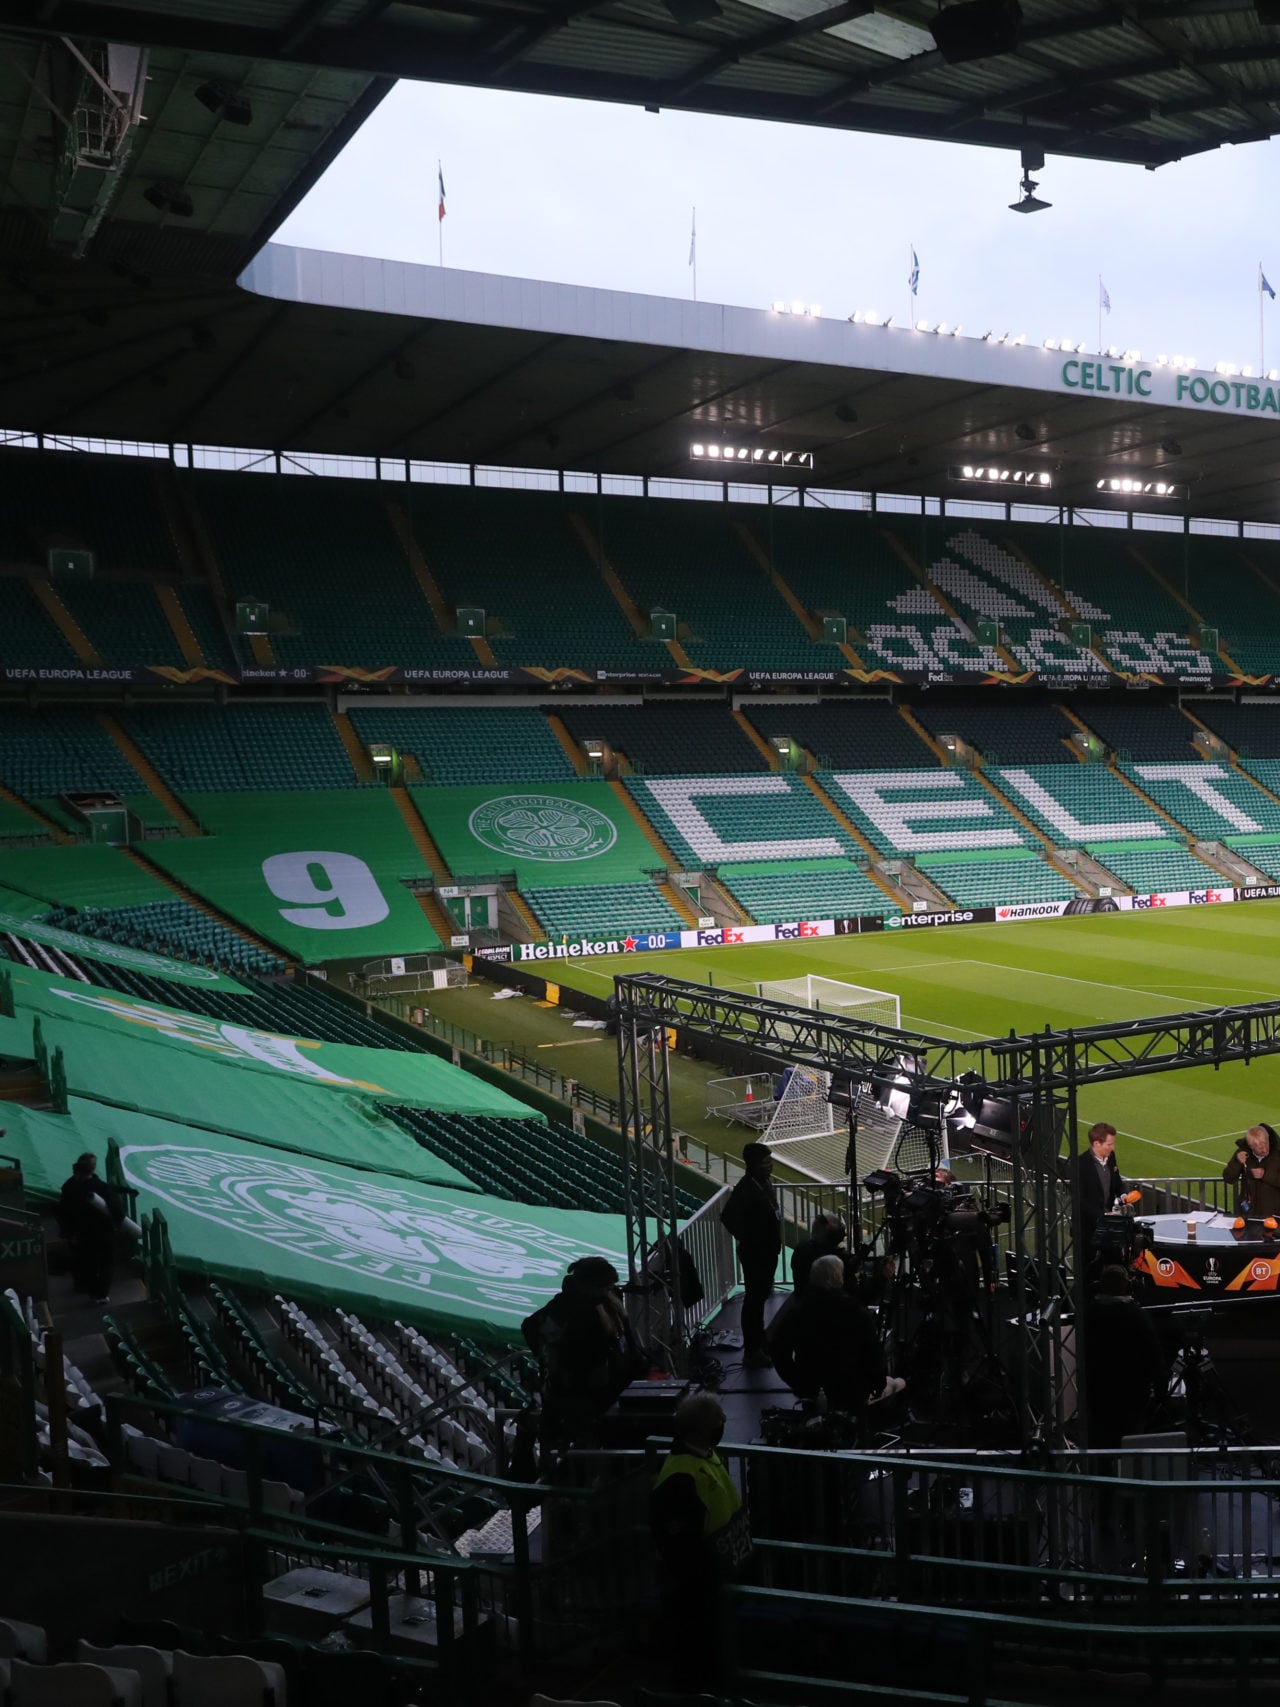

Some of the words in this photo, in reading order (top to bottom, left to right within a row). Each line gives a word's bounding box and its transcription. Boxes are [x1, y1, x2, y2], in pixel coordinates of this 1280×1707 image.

[1060, 360, 1152, 396] CELTIC
[6, 669, 36, 678] UEFA
[39, 669, 85, 679] EUROPA
[86, 670, 132, 680] LEAGUE
[404, 670, 430, 679] UEFA
[432, 670, 470, 679] EUROPA
[472, 670, 509, 679] LEAGUE
[749, 672, 771, 680] UEFA
[772, 672, 803, 680] EUROPA
[804, 672, 834, 680] LEAGUE
[483, 800, 511, 818] CELTIC
[512, 798, 577, 814] FOOTBALL
[479, 816, 491, 832] THE
[578, 808, 605, 828] CLUB
[547, 850, 577, 858] 1888
[261, 850, 391, 931] 9
[1189, 889, 1222, 905] FedEx
[1244, 886, 1267, 898] UEFA
[1132, 893, 1166, 909] FedEx
[886, 908, 974, 928] enterprise
[697, 928, 745, 947] FedEx
[775, 921, 820, 940] FedEx
[520, 940, 619, 961] Heineken
